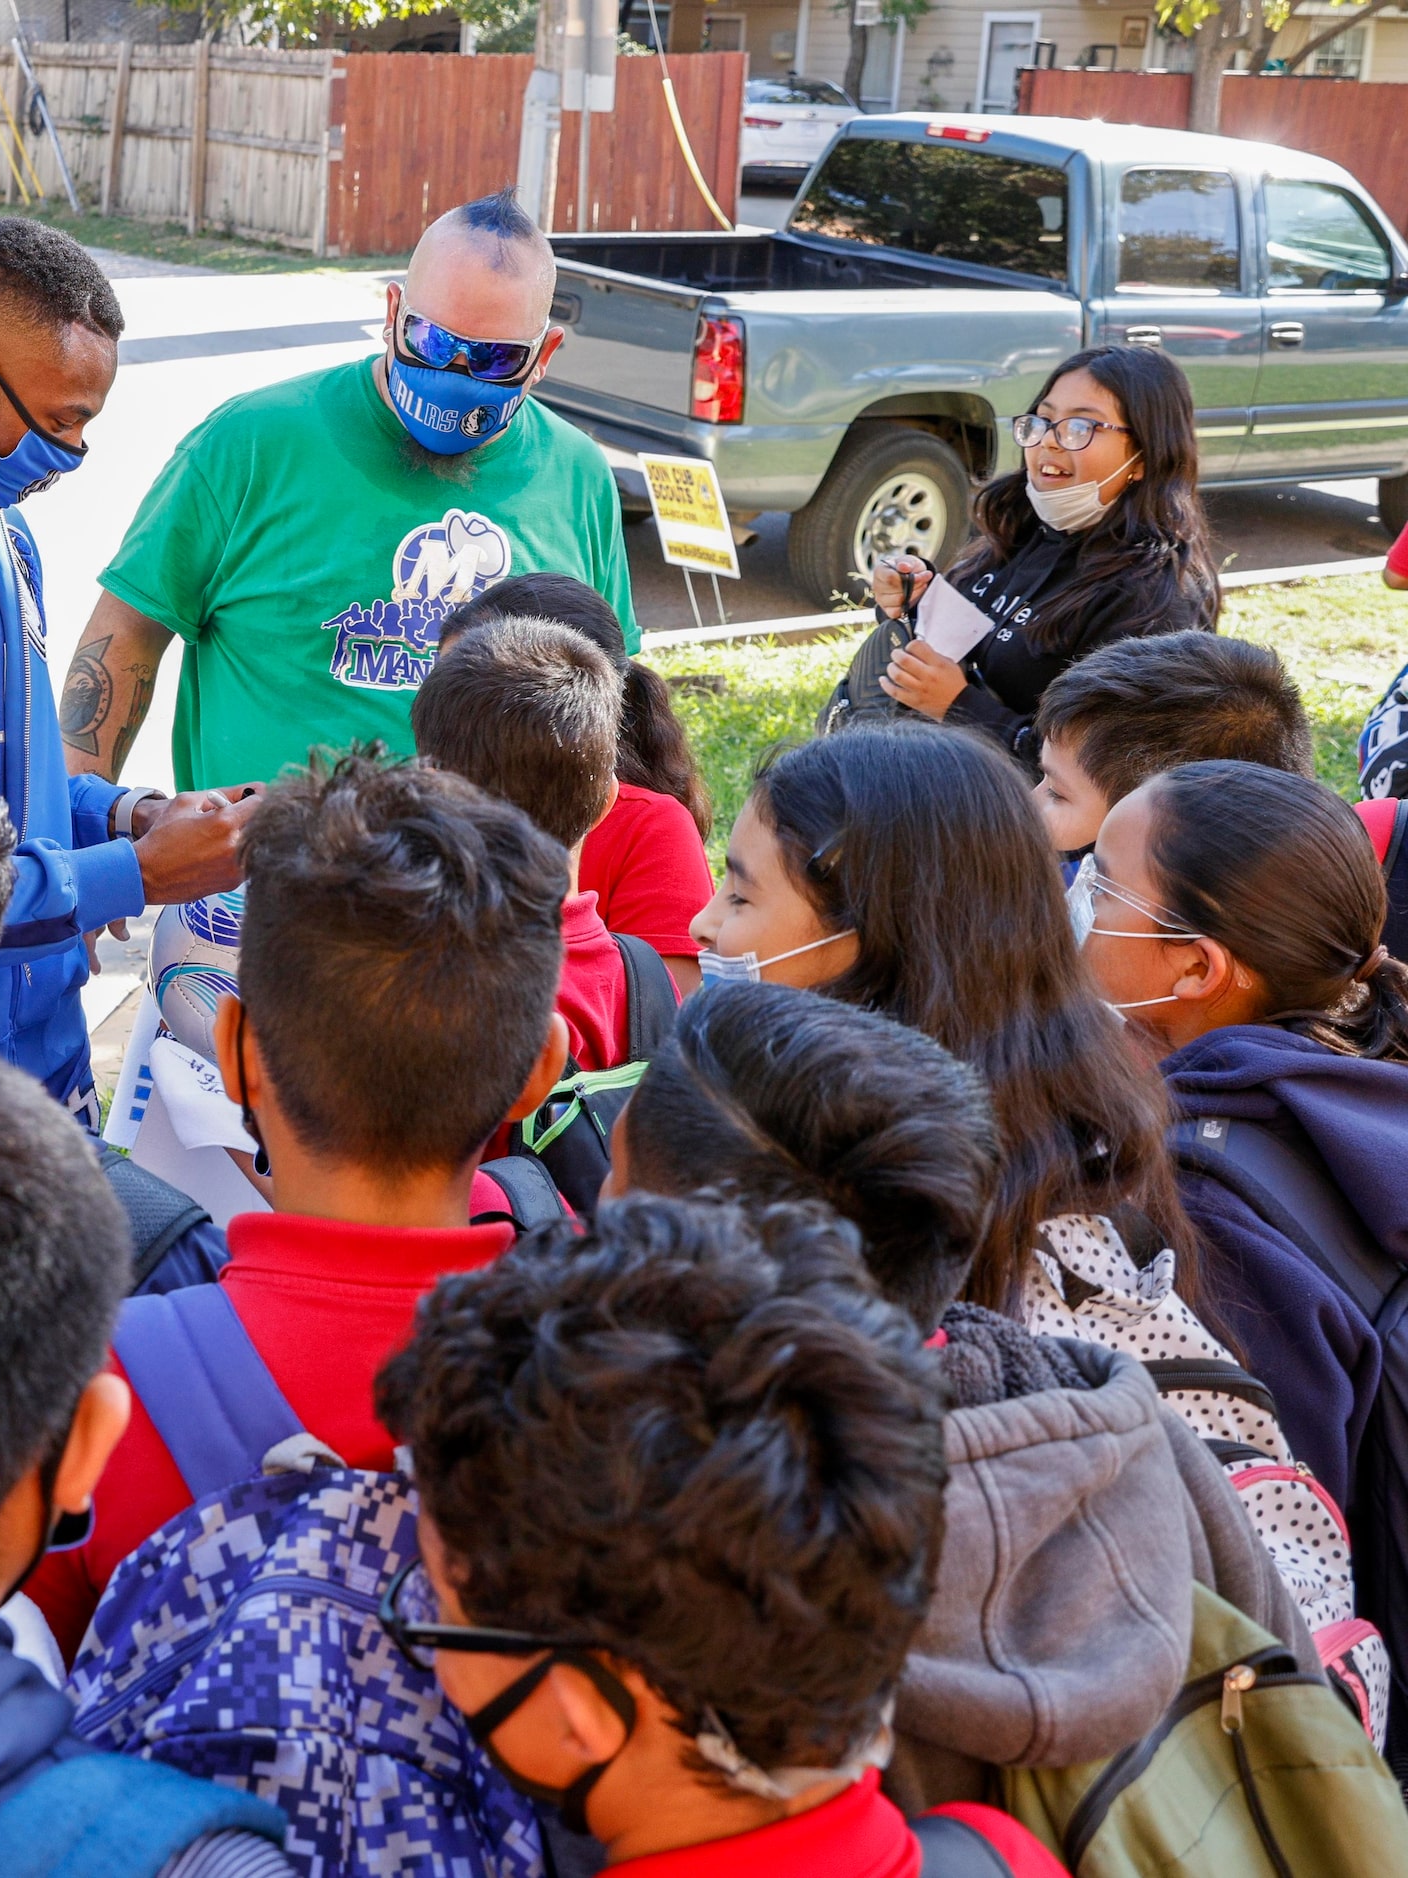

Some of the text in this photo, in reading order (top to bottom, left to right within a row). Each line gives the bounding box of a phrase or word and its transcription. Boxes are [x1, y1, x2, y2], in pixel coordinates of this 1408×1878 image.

[391, 366, 459, 433] DALLAS
[647, 463, 694, 486] JOIN CUB
[652, 483, 693, 504] SCOUTS
